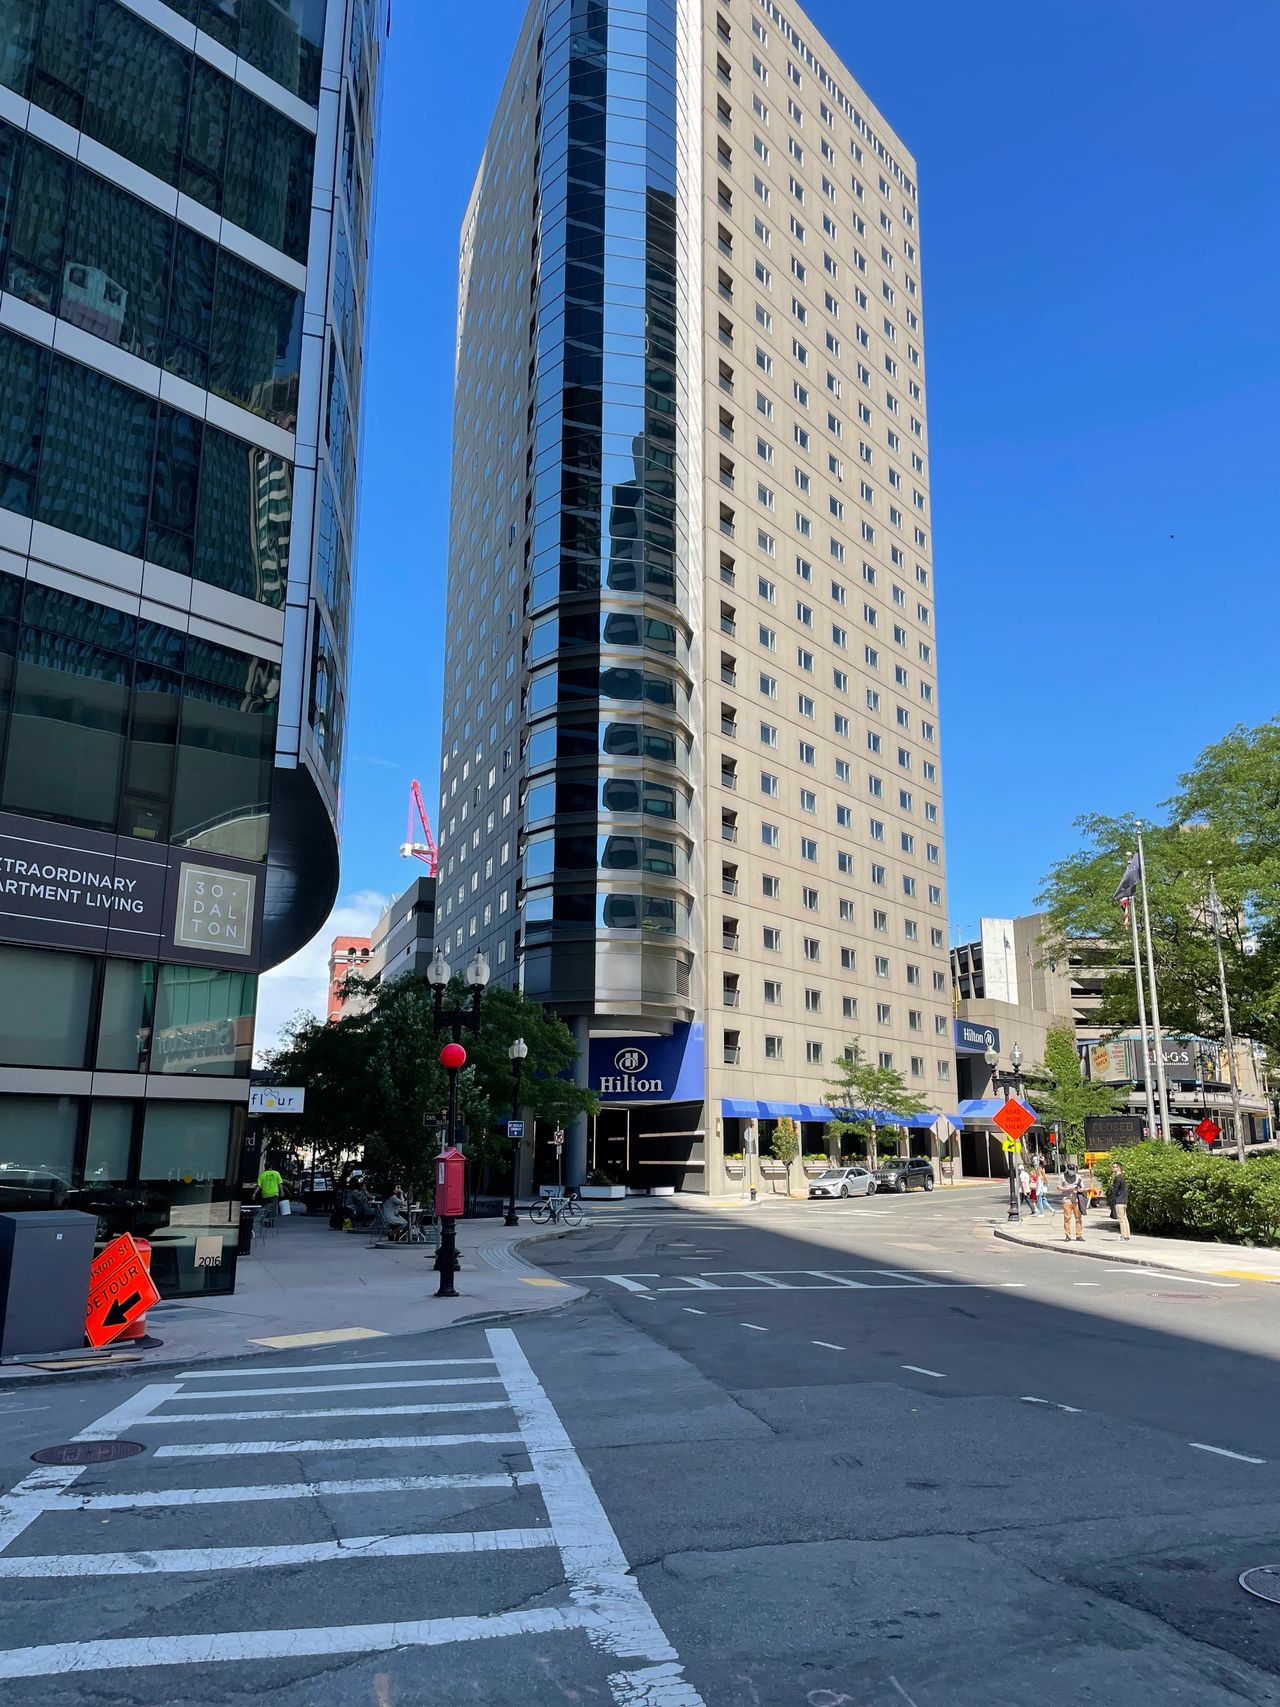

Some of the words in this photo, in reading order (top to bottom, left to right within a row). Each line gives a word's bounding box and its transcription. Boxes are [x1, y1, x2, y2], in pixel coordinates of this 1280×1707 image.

[0, 857, 137, 893] TRAORDINARY
[86, 892, 144, 914] LIVING
[193, 900, 237, 920] DAL
[192, 918, 237, 939] TON
[963, 1027, 984, 1044] Hilton
[600, 1074, 664, 1093] Hilton
[117, 1244, 129, 1256] St
[198, 1256, 222, 1267] 2016
[86, 1265, 140, 1318] DETOUR
